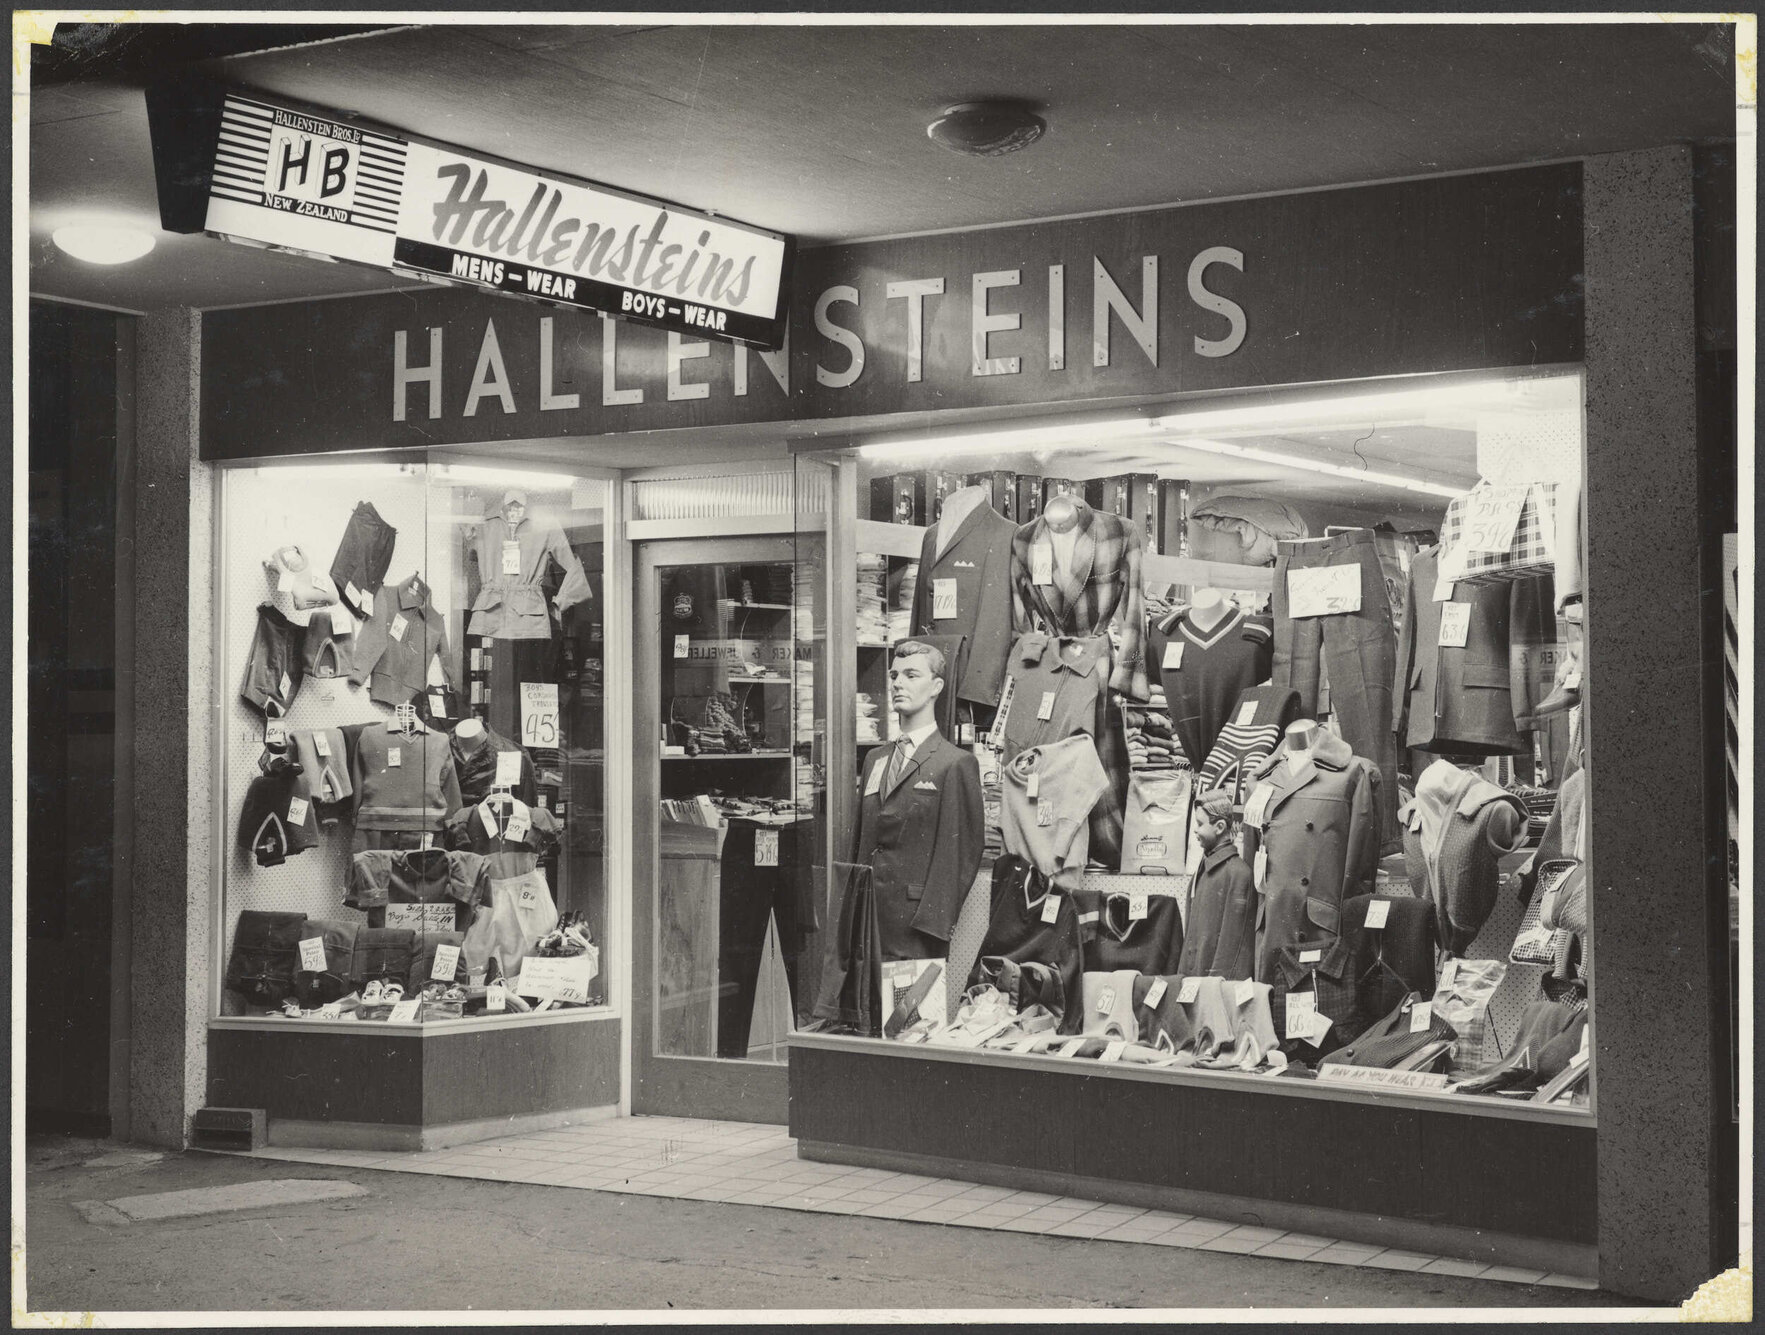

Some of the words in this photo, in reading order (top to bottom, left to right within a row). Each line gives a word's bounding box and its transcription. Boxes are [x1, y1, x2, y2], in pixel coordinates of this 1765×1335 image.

[275, 109, 331, 136] HALLENSTEIN
[264, 192, 291, 210] NEW
[296, 200, 348, 222] ZEALAND
[431, 162, 758, 307] Hallensteins
[451, 253, 505, 285] MENS
[527, 269, 576, 300] WEAR
[621, 290, 666, 319] BOYS
[684, 304, 727, 331] WEAR
